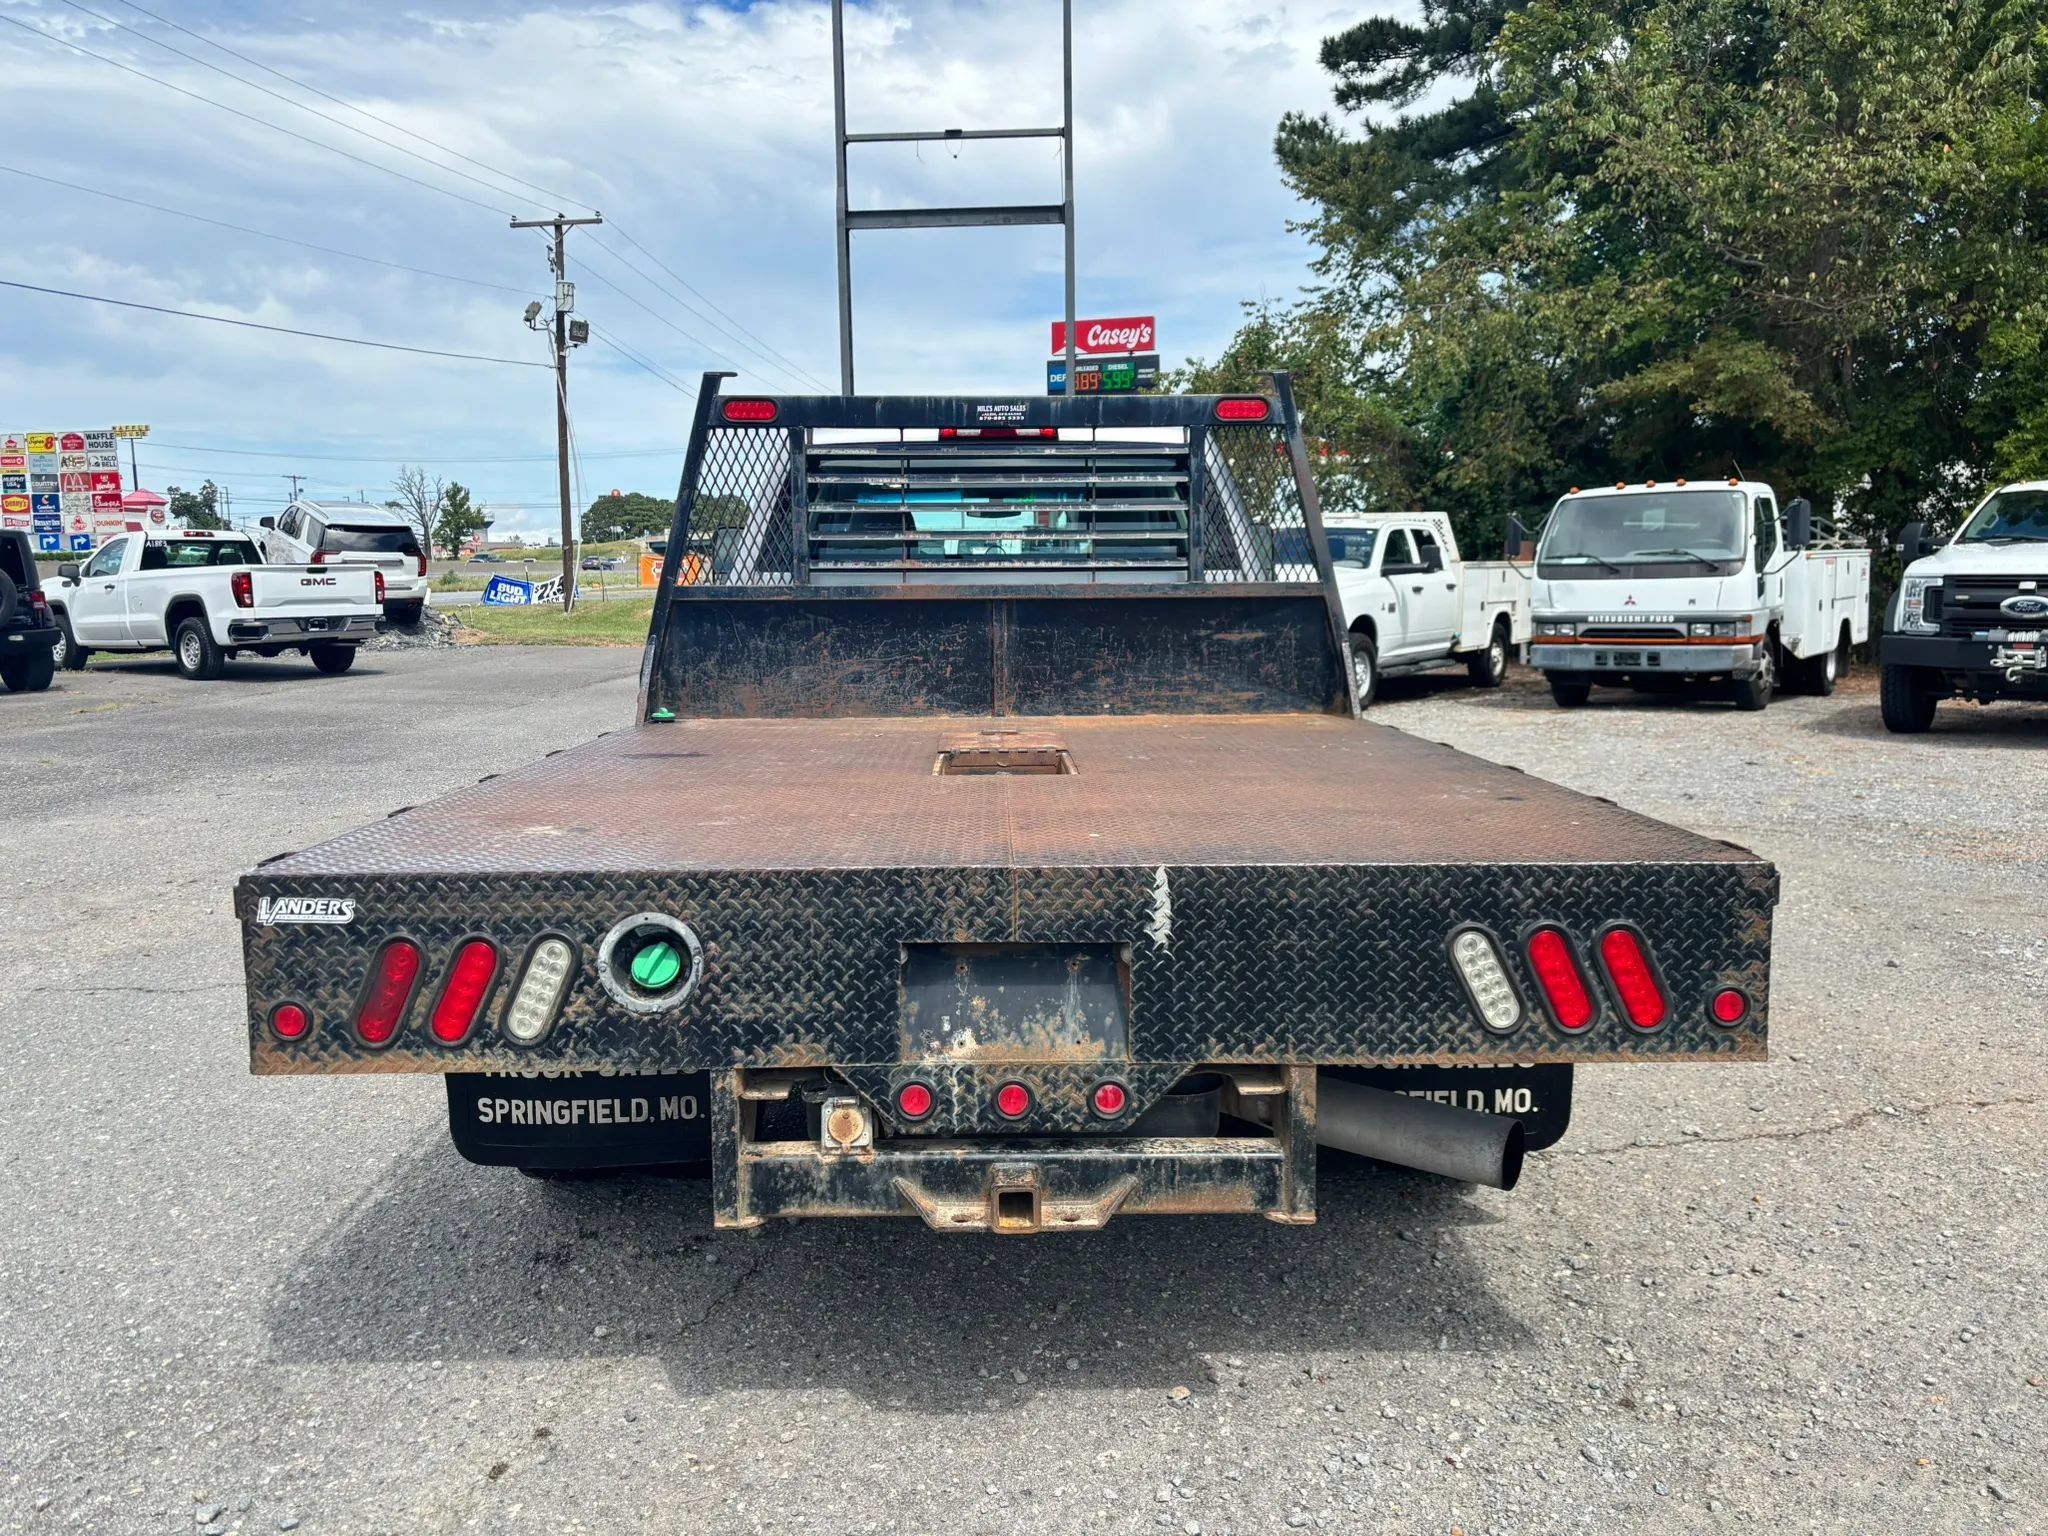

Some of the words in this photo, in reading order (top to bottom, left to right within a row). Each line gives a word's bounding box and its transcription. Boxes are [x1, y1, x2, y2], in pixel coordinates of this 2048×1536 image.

[1087, 323, 1152, 349] Casey's
[1010, 404, 1026, 412] SALES
[44, 436, 54, 450] 8
[85, 432, 115, 440] WAFFLE
[88, 441, 114, 449] HOUSE
[300, 578, 337, 586] GMC
[497, 582, 524, 596] BUD
[489, 589, 529, 605] LIGHT
[2014, 600, 2042, 612] Ford
[1588, 615, 1645, 623] MITSUBISHI
[1649, 615, 1675, 623] FUSO
[257, 897, 356, 925] LANDERS
[1494, 1087, 1539, 1114] MO.
[477, 1097, 655, 1125] SPRINGFIELD,
[660, 1095, 706, 1121] MO.
